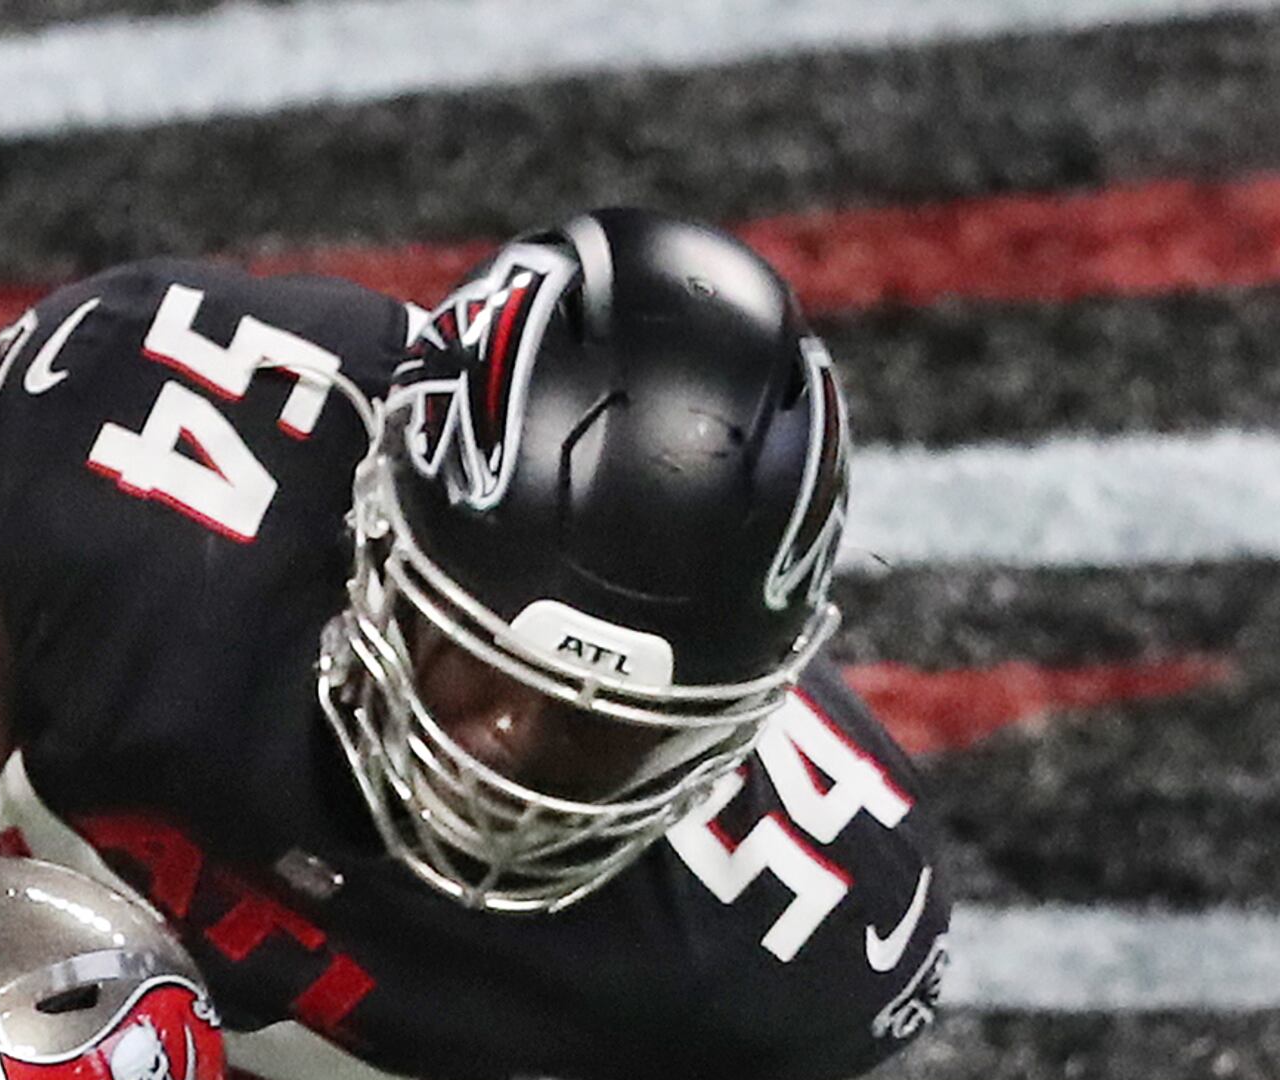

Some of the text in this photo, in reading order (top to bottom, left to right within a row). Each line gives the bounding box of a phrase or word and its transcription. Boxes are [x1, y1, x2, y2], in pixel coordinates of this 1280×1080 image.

[86, 283, 342, 544] 54
[557, 635, 631, 677] ATL
[664, 685, 917, 963] 54
